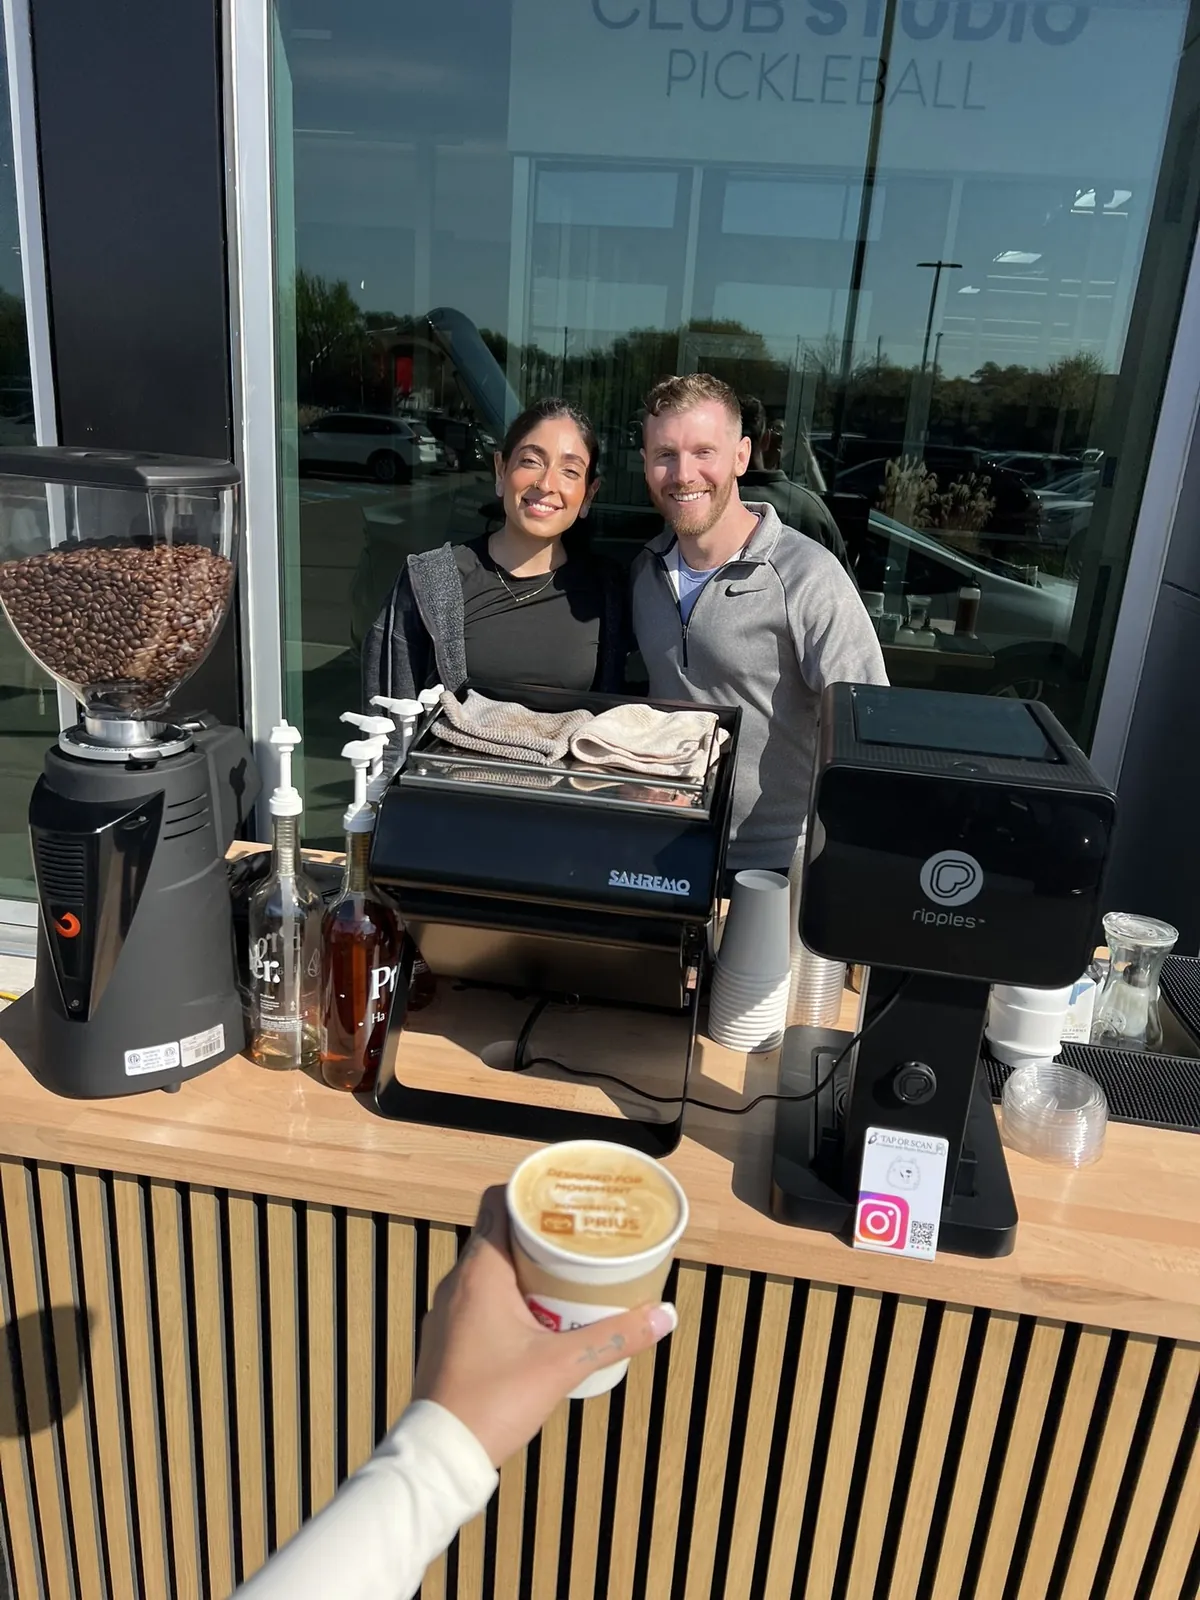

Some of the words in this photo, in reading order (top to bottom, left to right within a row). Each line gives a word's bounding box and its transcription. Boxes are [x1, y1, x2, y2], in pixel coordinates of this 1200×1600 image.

[666, 49, 986, 111] PICKLEBALL
[608, 869, 691, 895] SANREMO
[912, 907, 977, 929] ripples
[881, 1134, 897, 1145] TAP
[897, 1137, 910, 1146] OR
[911, 1139, 933, 1150] SCAN
[583, 1216, 640, 1231] PRIUS
